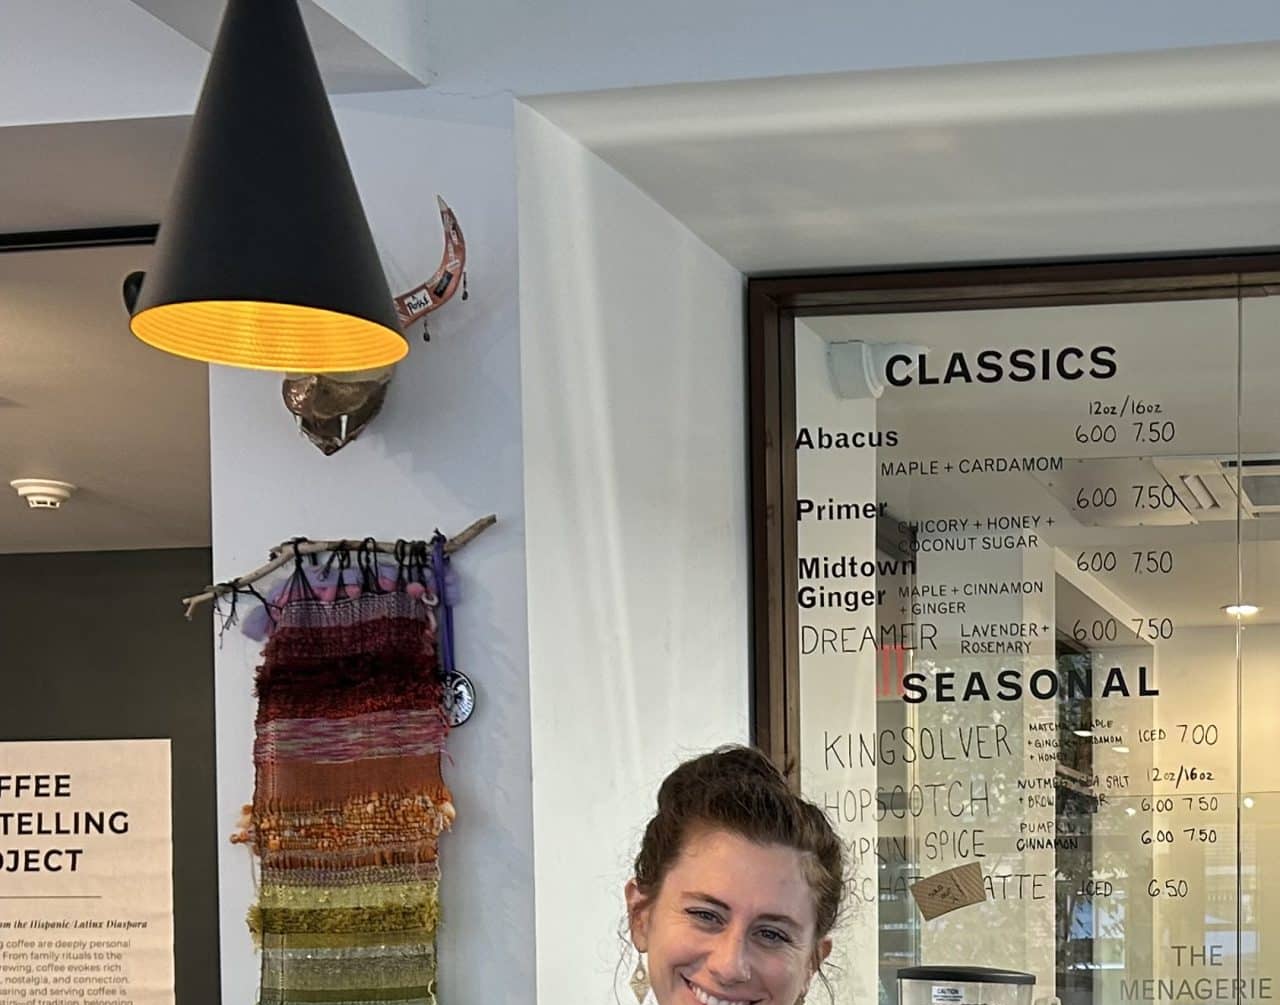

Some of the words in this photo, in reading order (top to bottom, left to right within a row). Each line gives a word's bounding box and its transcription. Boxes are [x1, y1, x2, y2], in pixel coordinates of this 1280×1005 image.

[885, 346, 1118, 387] CLASSICS
[795, 428, 900, 451] Abacus
[1133, 421, 1176, 443] 7.50
[881, 461, 939, 476] MAPLE
[943, 464, 954, 474] +
[958, 456, 1064, 474] CARDAMOM
[1132, 485, 1176, 510] 7.50
[797, 499, 888, 522] Primer
[899, 519, 970, 536] CHICORY
[973, 517, 983, 530] +
[986, 516, 1042, 531] HONEY
[1047, 517, 1056, 528] +
[900, 537, 977, 554] COCONUT
[982, 535, 1039, 550] SUGAR
[798, 555, 917, 580] Midtown
[797, 586, 887, 613] Ginger
[899, 584, 948, 600] MAPLE
[950, 585, 960, 596] +
[963, 581, 1045, 597] CINNAMON
[911, 602, 967, 616] GINGER
[801, 623, 938, 656] DREAMER
[960, 623, 1039, 640] LAVENDER
[960, 640, 1032, 655] ROSEMARY
[902, 666, 1160, 704] SEASONAL
[823, 723, 1014, 771] KINGSOLVER
[1138, 728, 1167, 743] ICED
[824, 780, 991, 823] HOPSCOTCH
[1105, 774, 1131, 789] SALT
[1140, 798, 1174, 813] 6.00
[924, 828, 987, 862] SPICE
[1015, 837, 1079, 852] CINNAMON
[0, 849, 83, 872] JECT
[1079, 879, 1114, 898] ICED
[106, 920, 148, 931] Diaspora
[6, 940, 36, 949] coffee
[55, 940, 87, 950] deeply
[89, 940, 131, 950] personal
[1170, 944, 1224, 967] THE
[30, 952, 59, 962] family
[62, 952, 92, 961] rituals
[36, 963, 66, 972] coffee
[67, 963, 101, 972] evokes
[5, 975, 51, 986] nostalgia,
[1120, 977, 1273, 1000] MENAGERIE
[50, 988, 85, 997] serving
[87, 987, 117, 996] coffee
